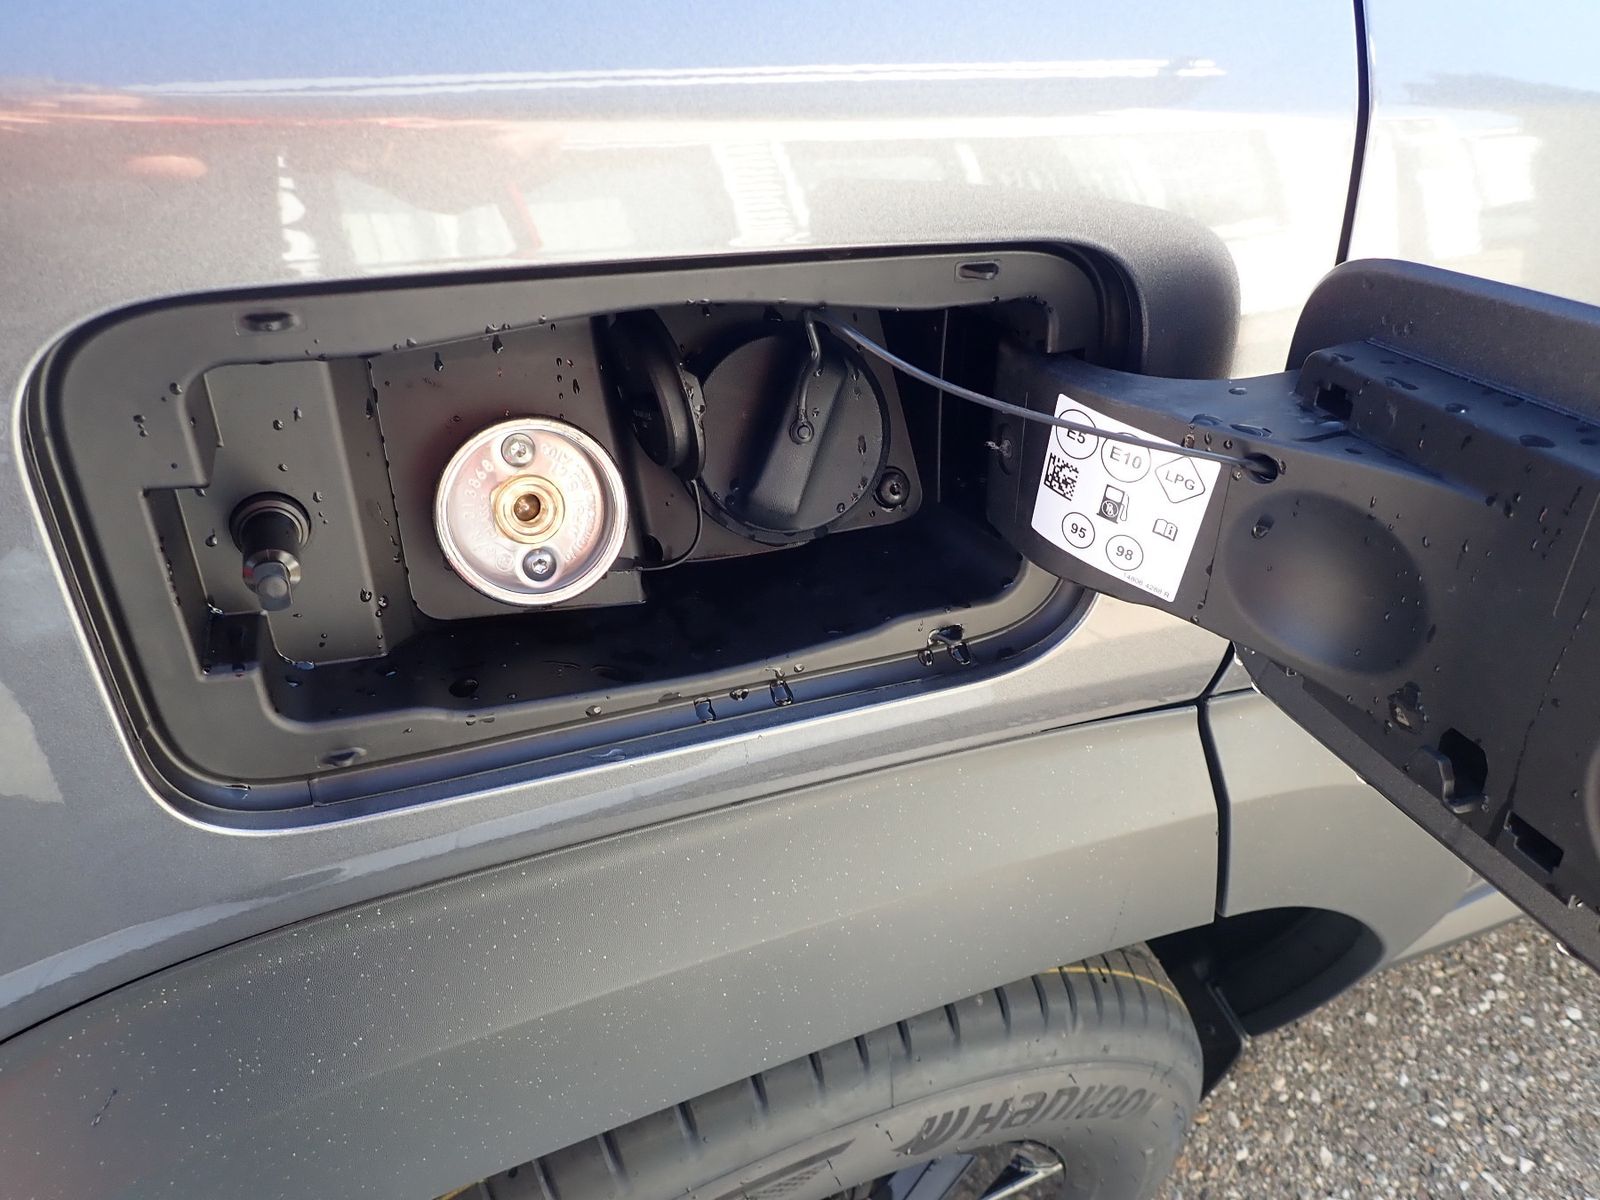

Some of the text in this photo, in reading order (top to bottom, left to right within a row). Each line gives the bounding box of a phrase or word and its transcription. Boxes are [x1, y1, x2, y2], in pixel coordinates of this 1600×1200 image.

[1109, 446, 1142, 470] E10
[1165, 470, 1195, 491] LPG
[1070, 522, 1087, 539] 95
[1115, 545, 1133, 561] 98
